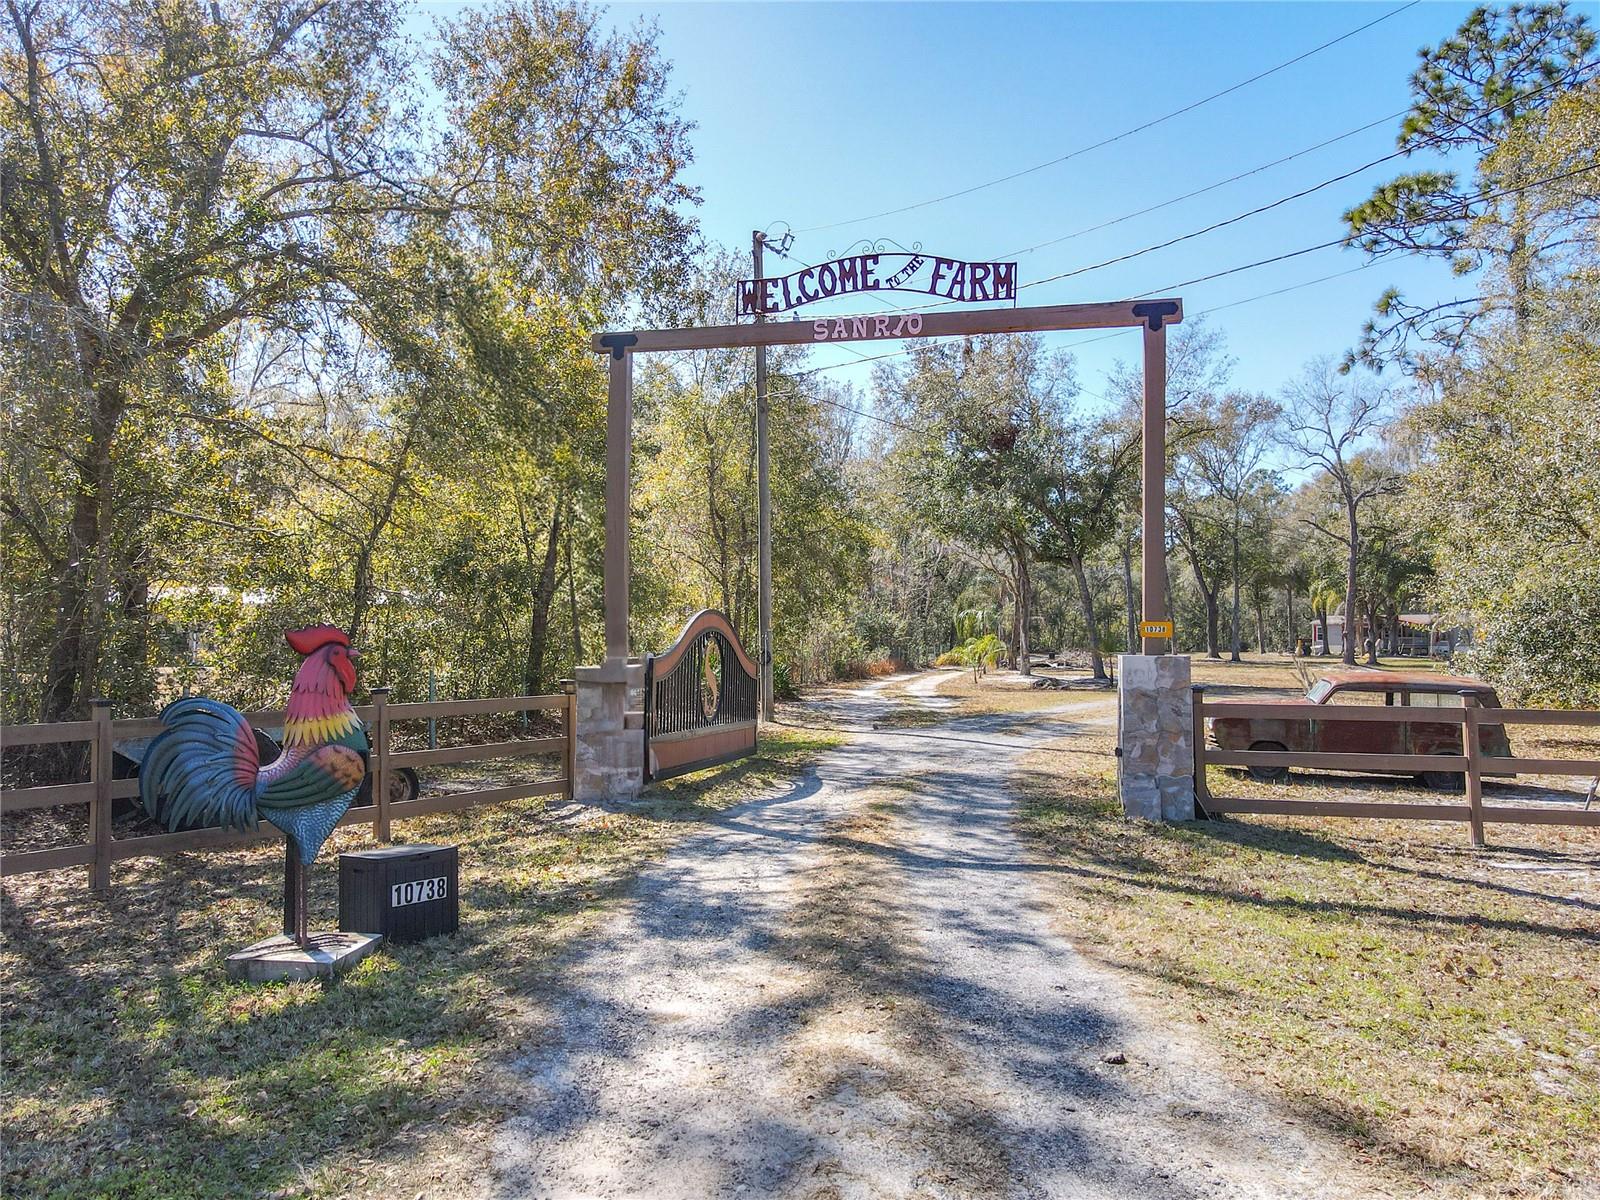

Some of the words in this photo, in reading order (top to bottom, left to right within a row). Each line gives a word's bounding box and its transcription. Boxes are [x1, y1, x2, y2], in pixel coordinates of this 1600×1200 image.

[741, 255, 880, 314] WELCOME
[885, 277, 901, 290] TO
[901, 255, 925, 278] THE
[929, 257, 1013, 301] FARM
[394, 878, 446, 906] 10738
